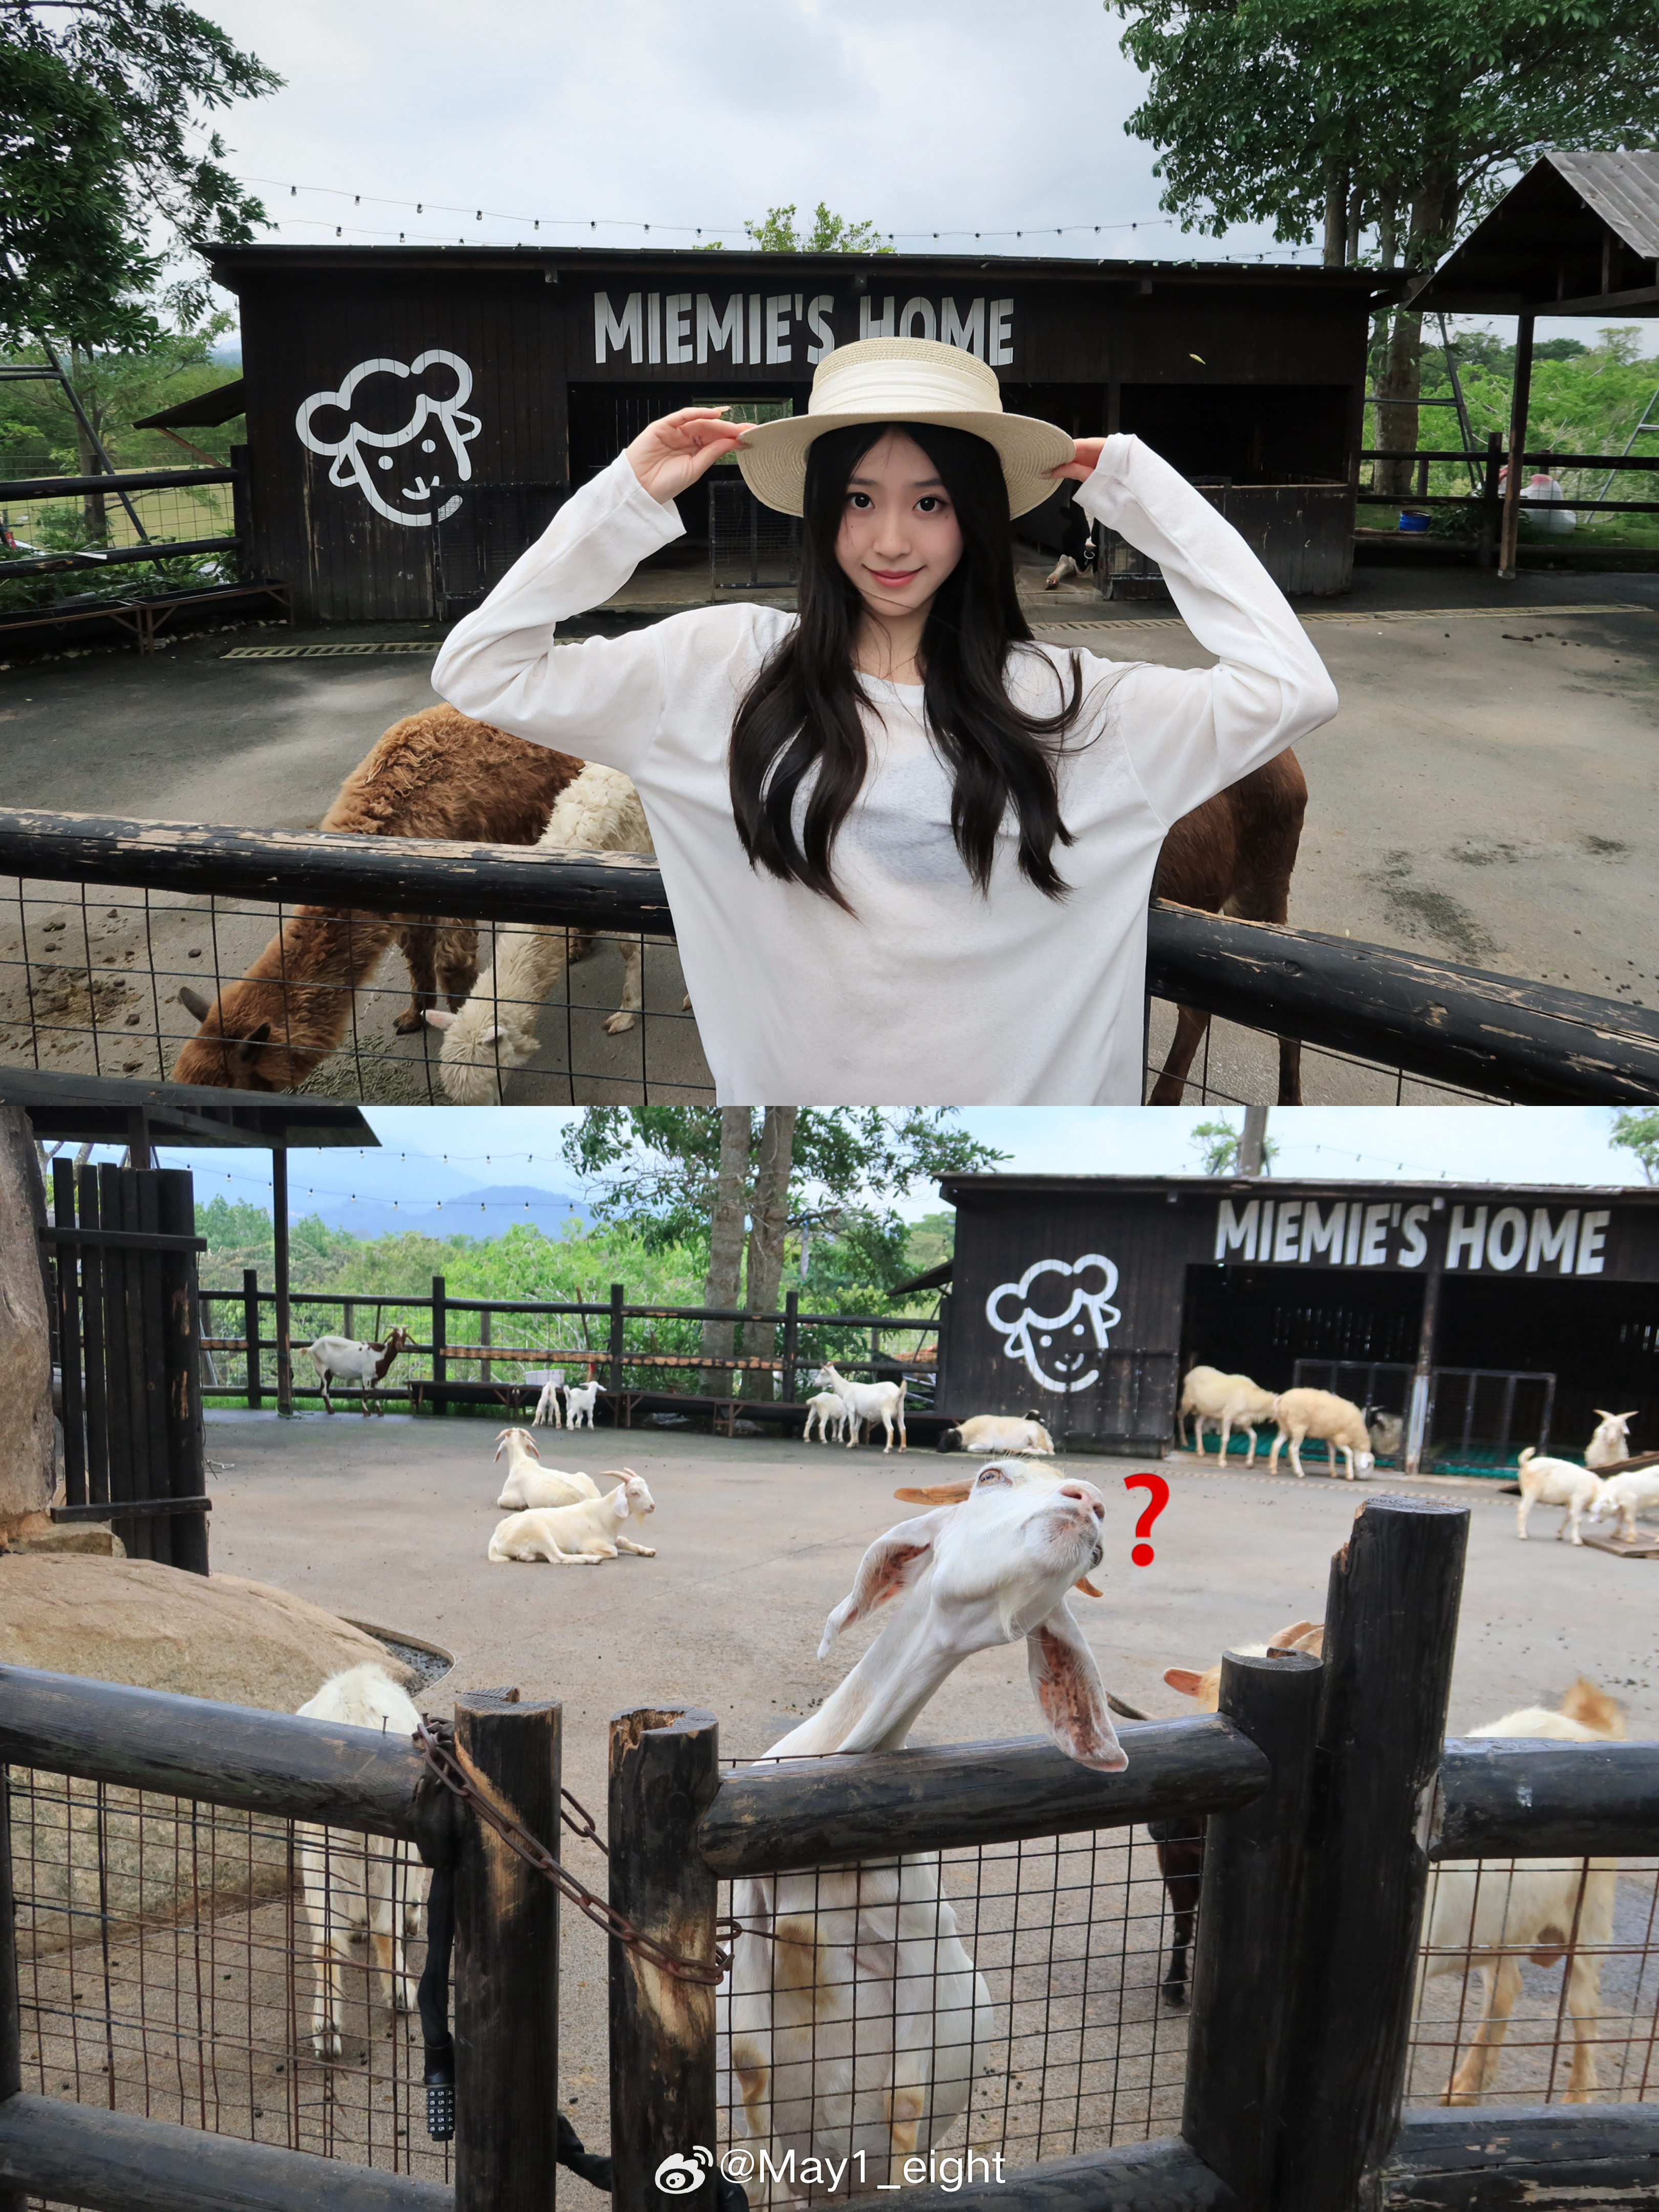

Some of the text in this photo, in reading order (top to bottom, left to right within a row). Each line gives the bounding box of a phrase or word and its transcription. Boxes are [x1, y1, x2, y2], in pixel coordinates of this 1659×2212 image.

[594, 291, 1014, 366] MIEMIE'S HOME
[1214, 1200, 1611, 1275] MIEMIE'S HOME
